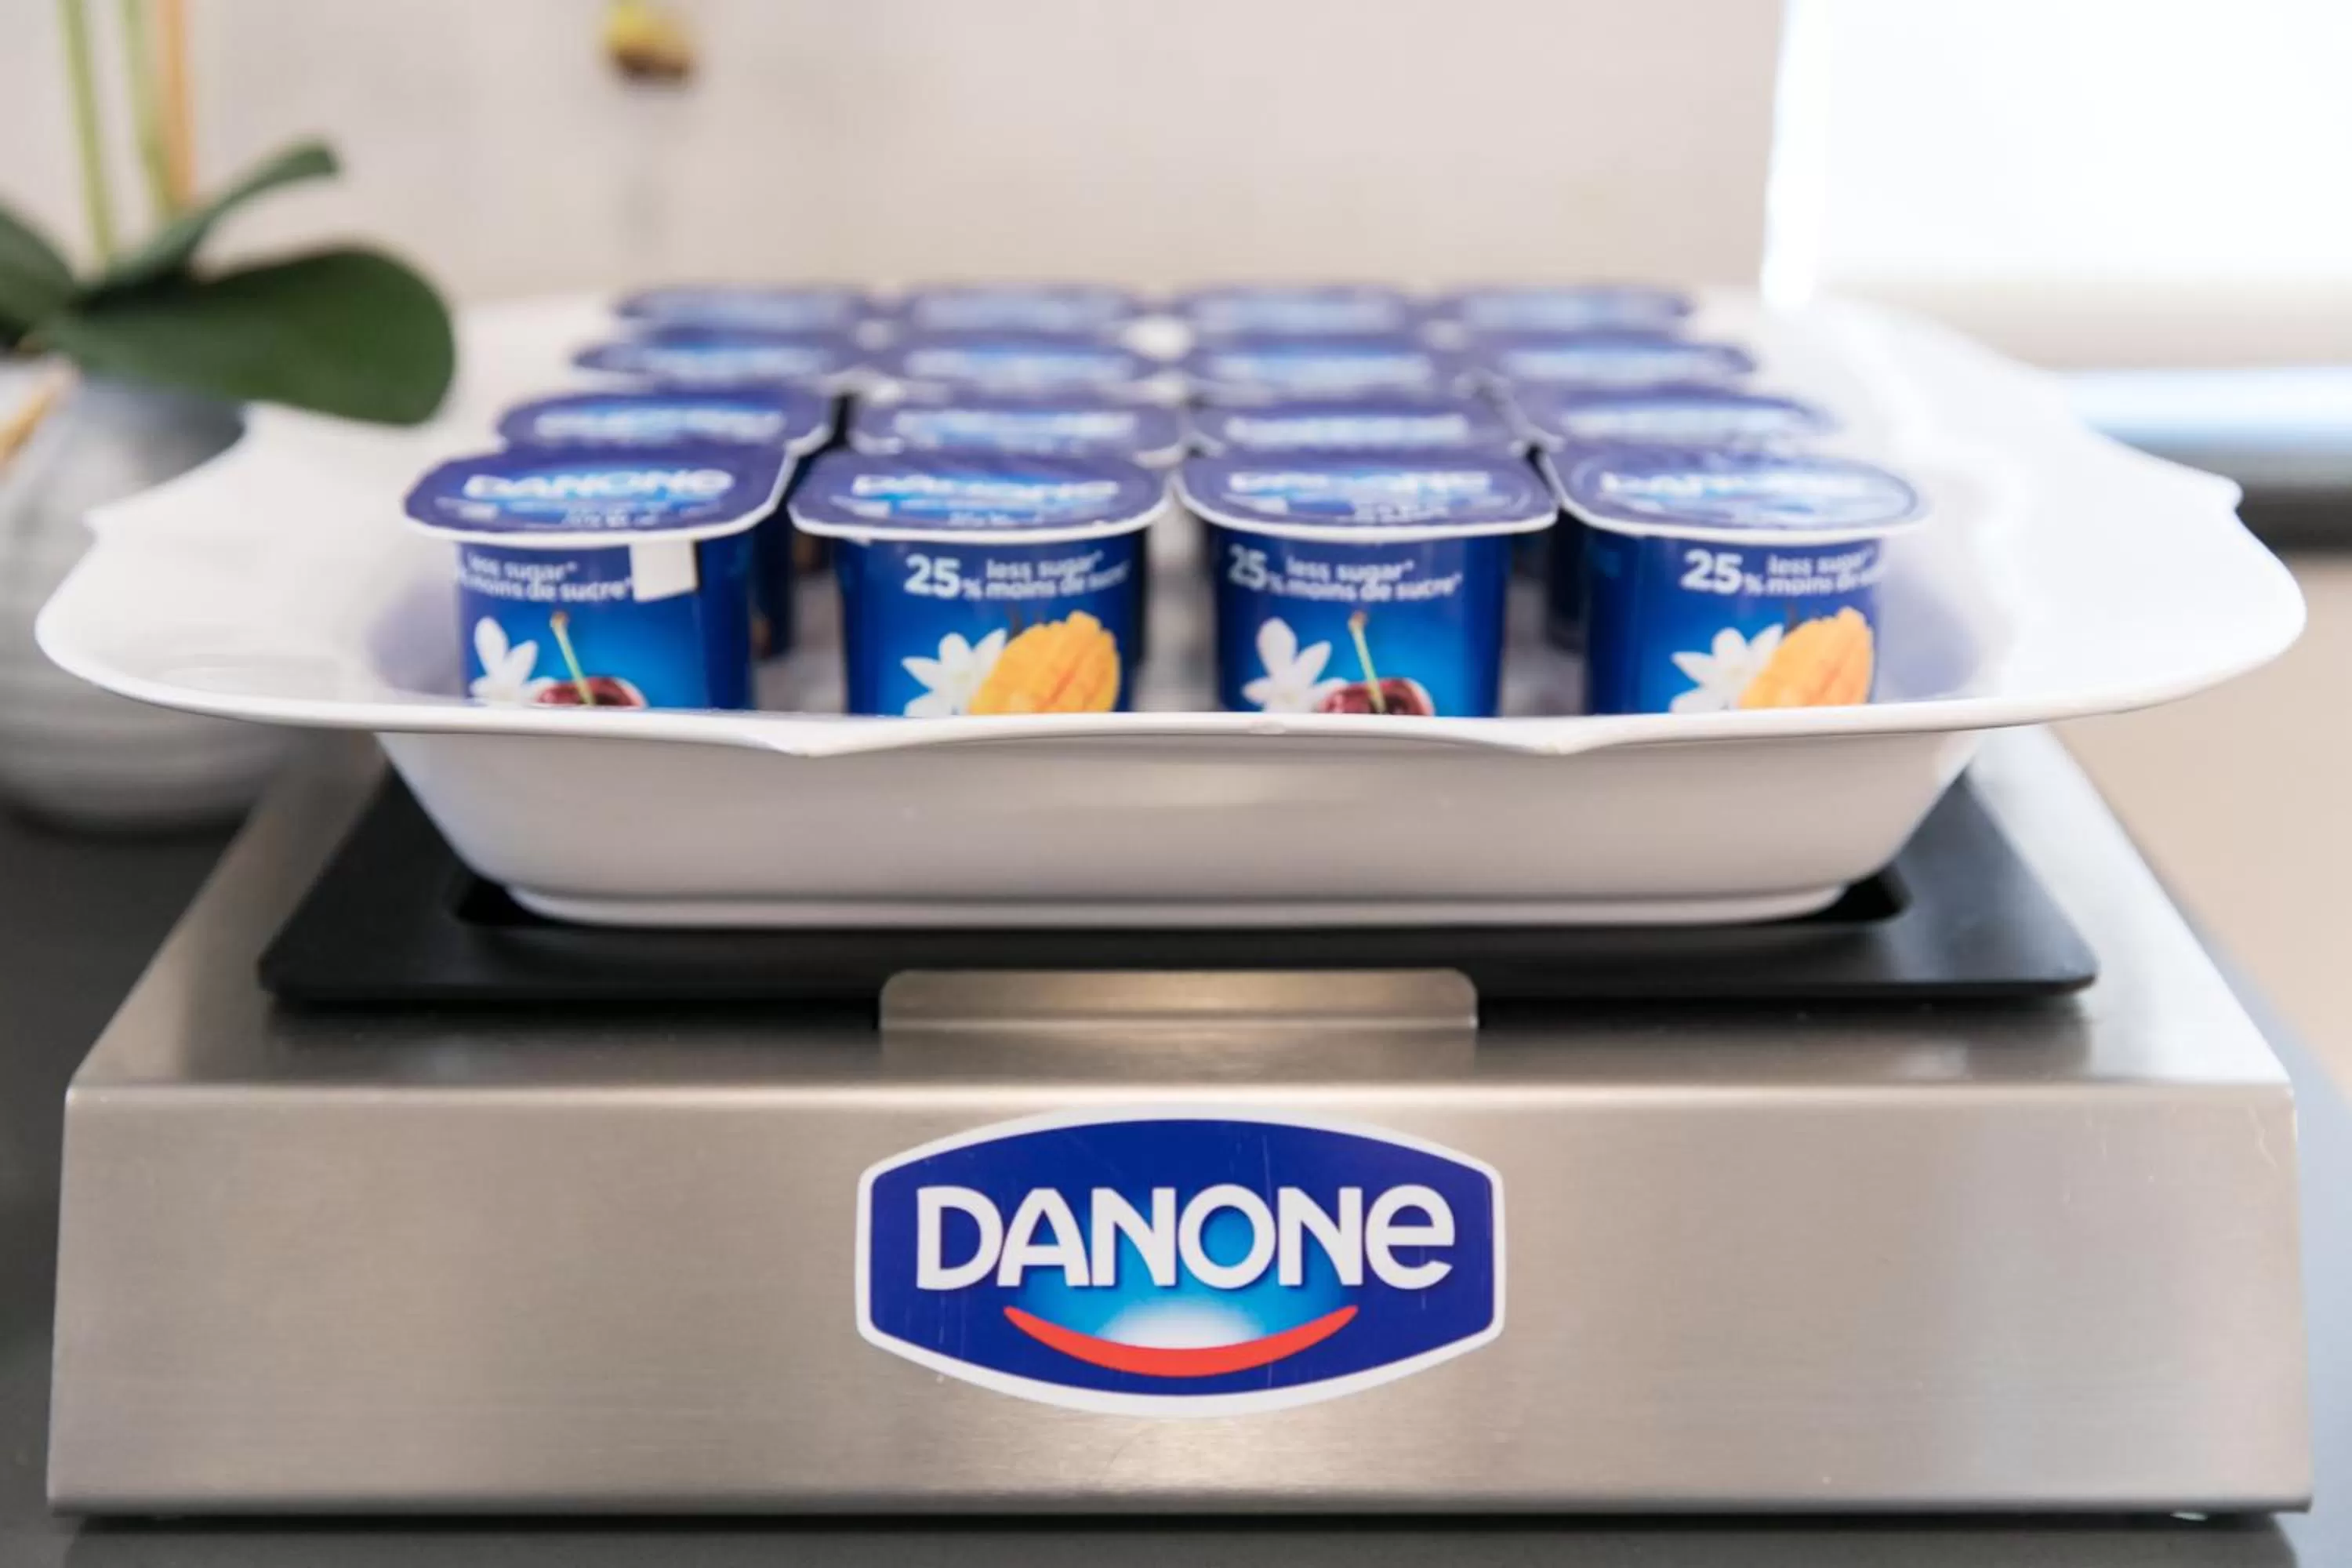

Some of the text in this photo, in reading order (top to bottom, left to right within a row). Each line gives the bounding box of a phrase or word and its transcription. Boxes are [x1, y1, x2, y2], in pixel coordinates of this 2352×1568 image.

[985, 558, 1033, 582] less
[1286, 554, 1330, 583] less
[1766, 553, 1813, 578] less
[1287, 577, 1356, 601] moins
